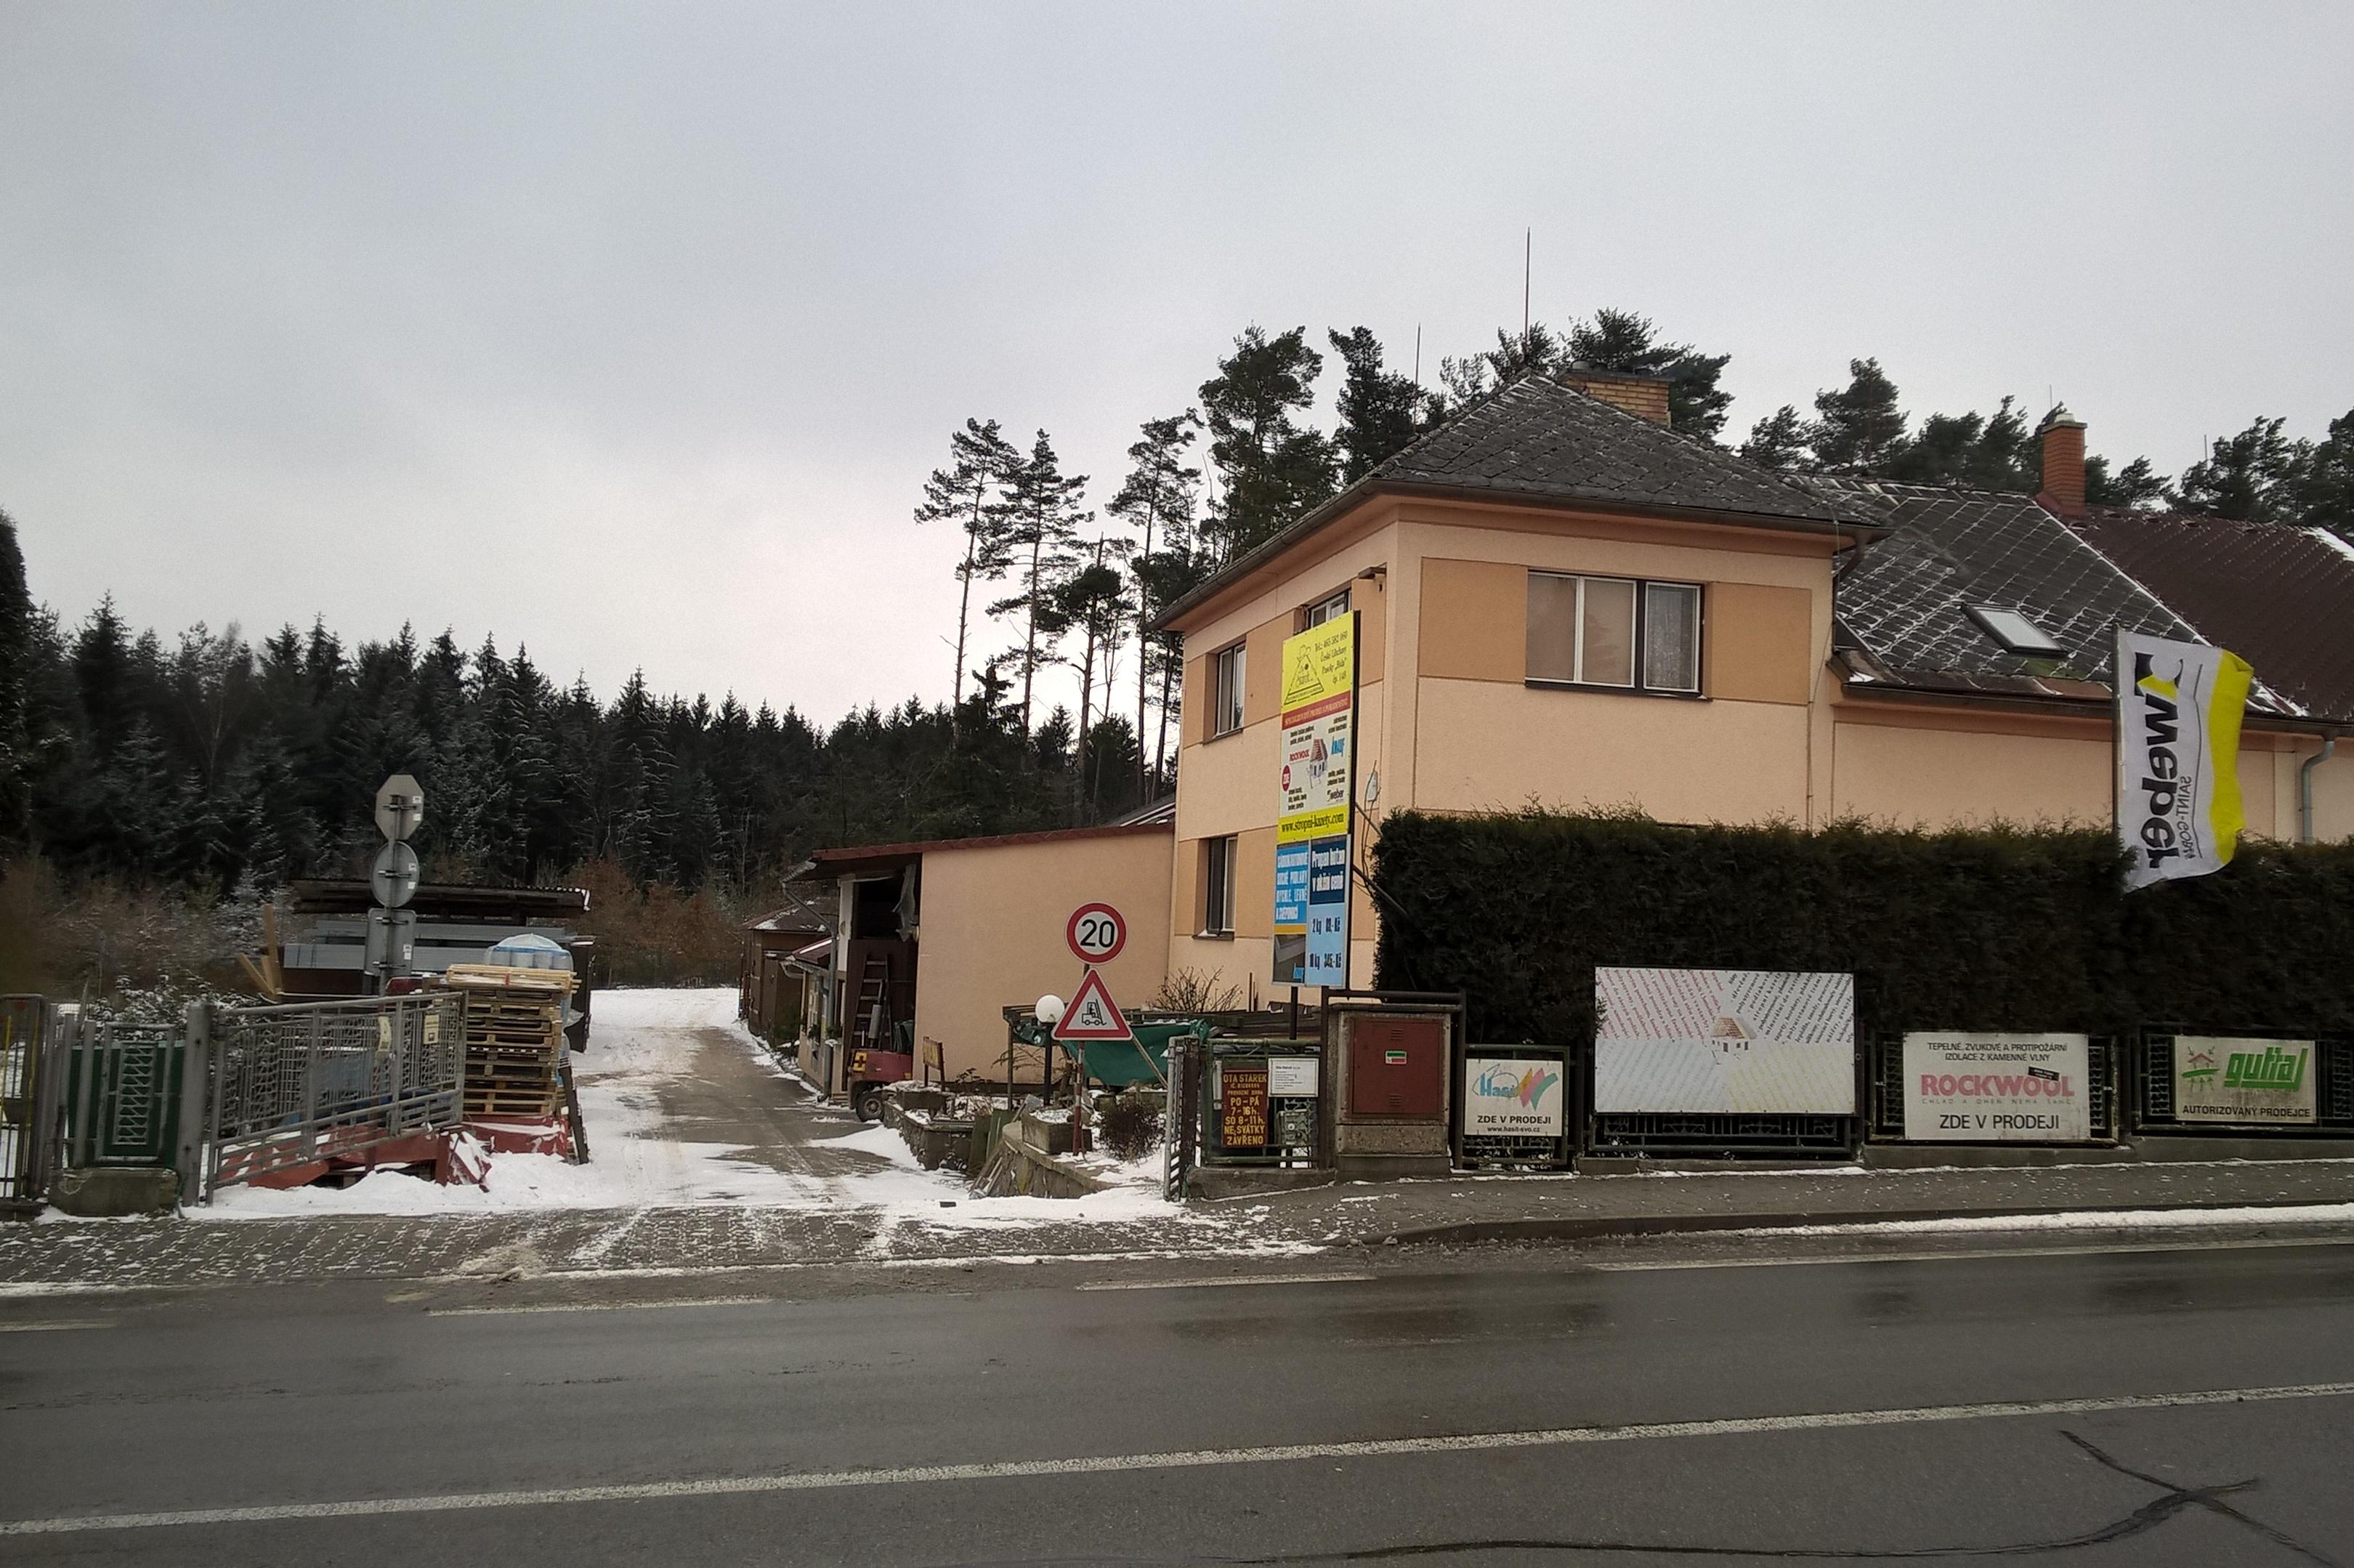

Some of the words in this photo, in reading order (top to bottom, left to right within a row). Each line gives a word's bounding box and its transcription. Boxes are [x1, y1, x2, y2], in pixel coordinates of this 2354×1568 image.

[1080, 919, 1115, 948] 20
[1965, 1043, 2002, 1051] ZVUKOVÉ
[2011, 1043, 2068, 1052] PROTIPOŽÁRNÍ
[1987, 1053, 2027, 1062] KAMENNÉ
[1223, 1074, 1238, 1083] OTA
[1239, 1073, 1267, 1083] STÁREK
[1920, 1074, 2075, 1097] ROCKWOOL
[2183, 1104, 2258, 1115] AUTORIZOVANÝ
[2260, 1108, 2310, 1118] PRODEJCE
[1225, 1115, 1236, 1125] SO
[1477, 1115, 1497, 1124] ZDE
[1500, 1115, 1507, 1124] V
[1510, 1115, 1551, 1124] PRODEJI
[1940, 1115, 1971, 1129] ZDE
[1975, 1115, 1987, 1129] V
[1993, 1115, 2059, 1130] PRODEJI
[1226, 1133, 1264, 1146] ZAVŘENO
